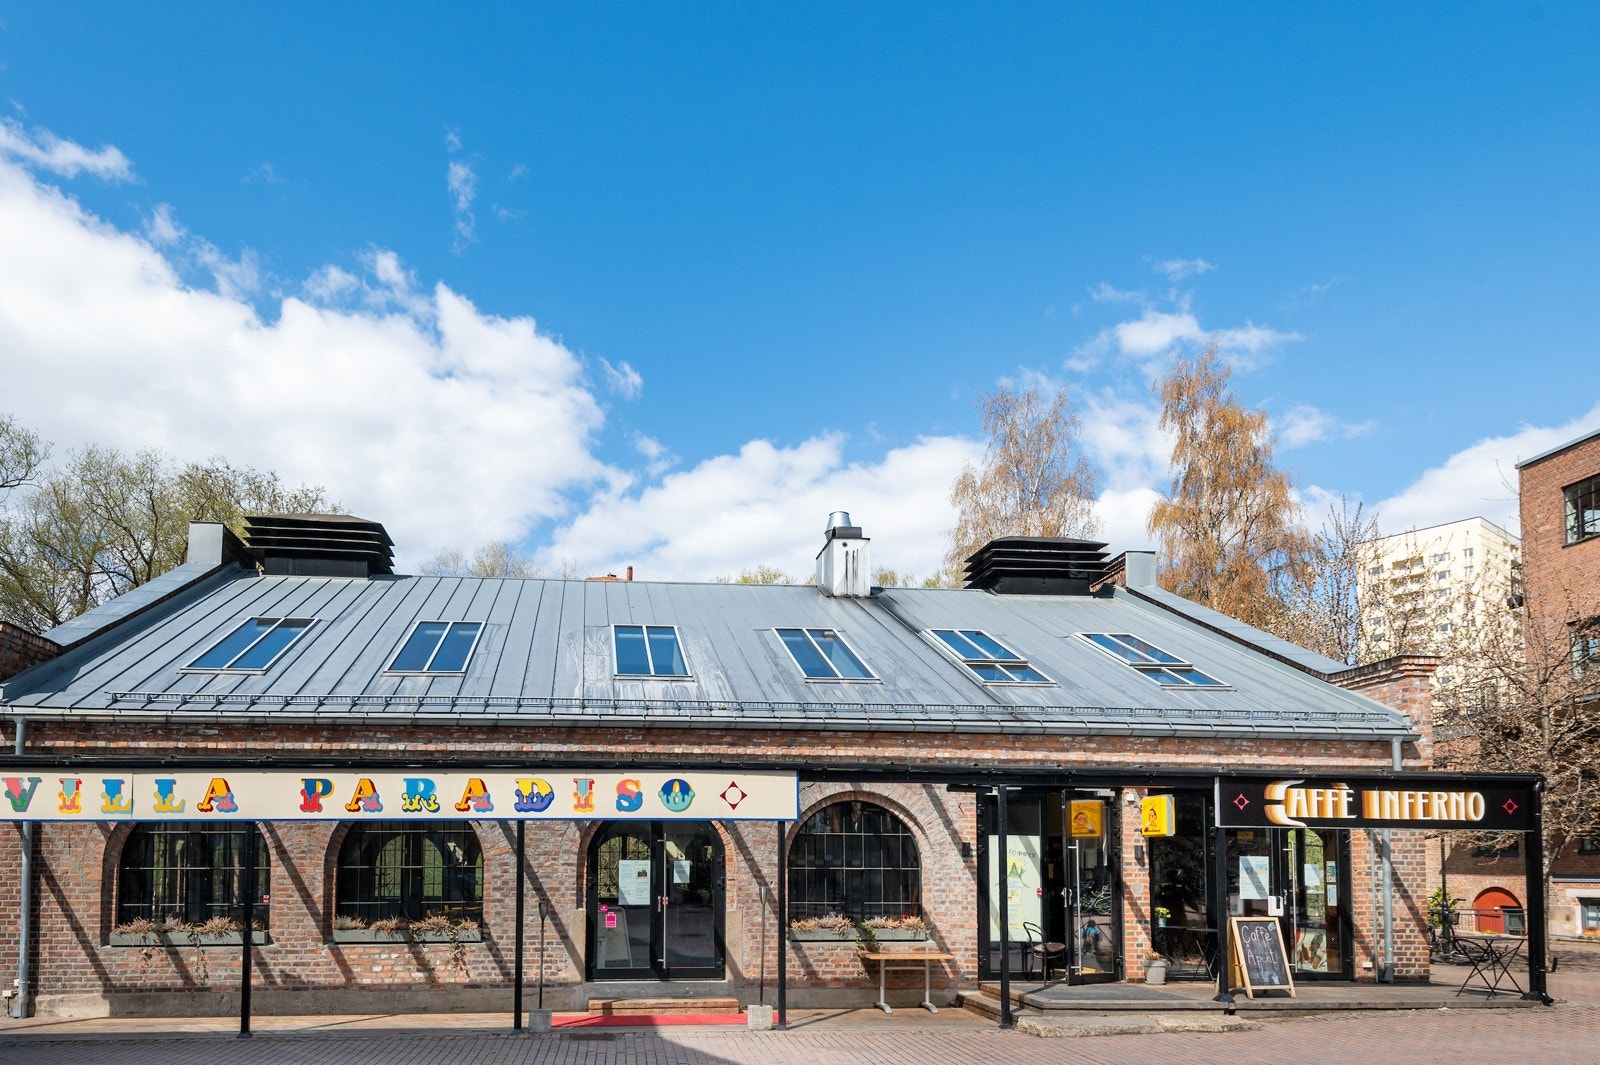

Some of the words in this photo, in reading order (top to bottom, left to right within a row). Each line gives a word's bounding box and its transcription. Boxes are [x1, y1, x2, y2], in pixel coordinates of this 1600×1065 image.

[1, 776, 239, 814] VILLA
[299, 777, 697, 813] PARADISO
[1263, 779, 1357, 828] CAFFÈ
[1362, 790, 1486, 821] INFERNO
